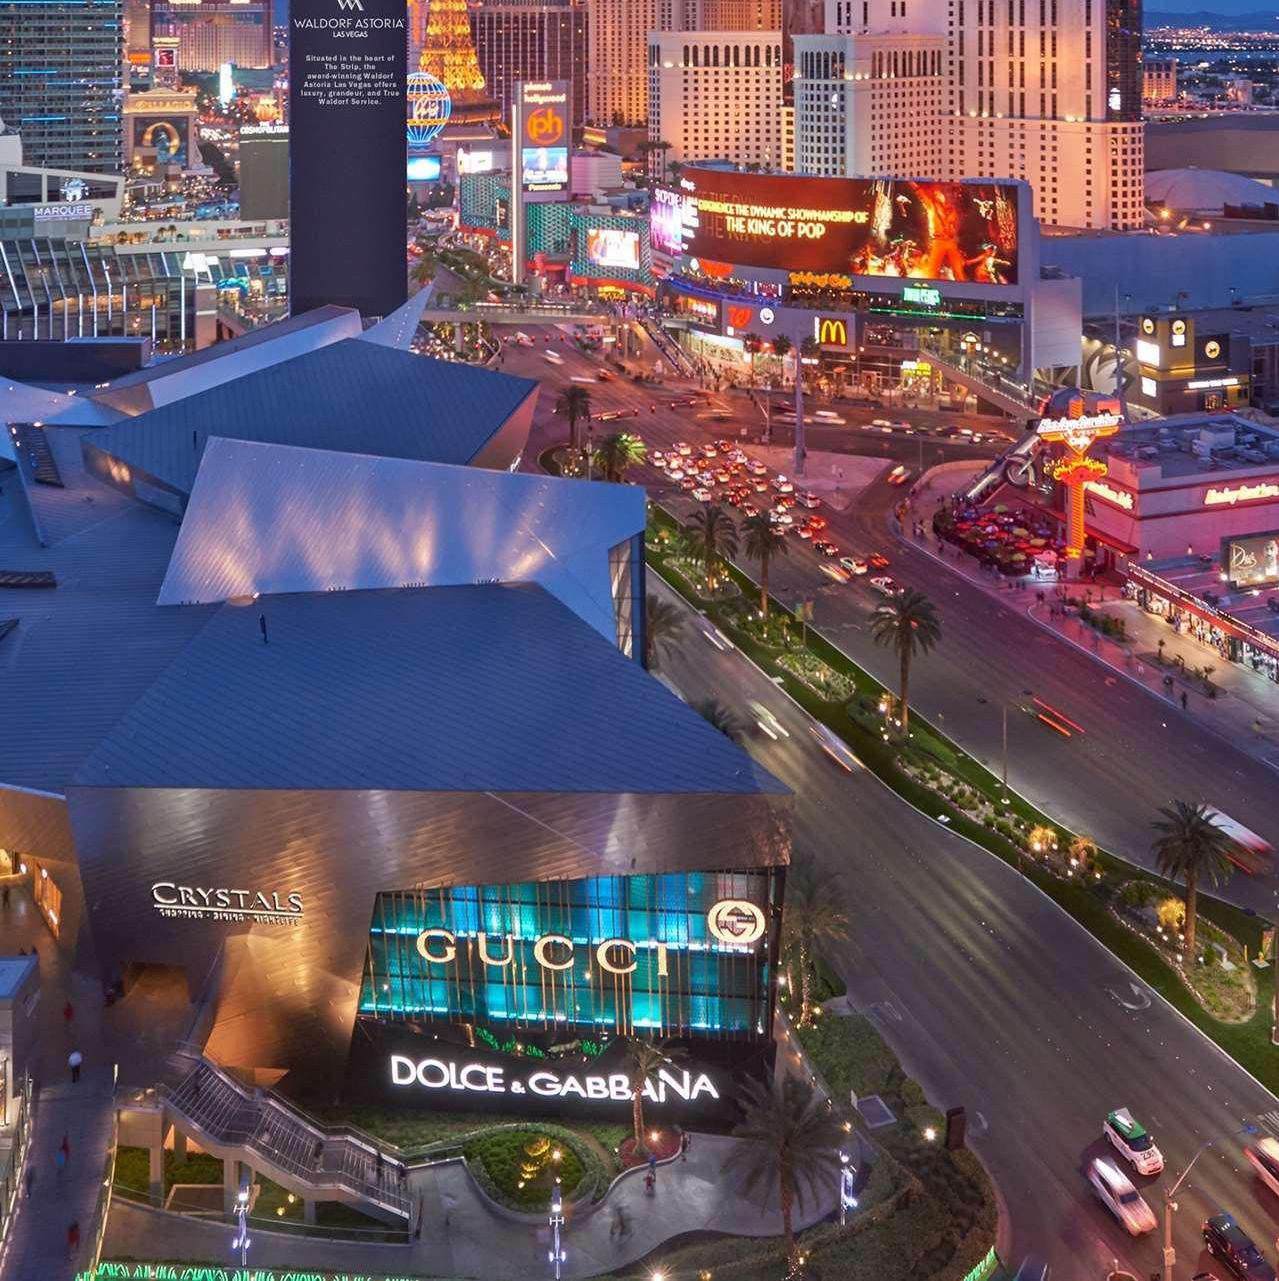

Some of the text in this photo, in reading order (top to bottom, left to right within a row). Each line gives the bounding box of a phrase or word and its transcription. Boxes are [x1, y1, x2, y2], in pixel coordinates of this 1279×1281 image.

[294, 18, 404, 29] WALDORF ASTORIA
[332, 30, 368, 38] LAS VEGAS
[305, 54, 395, 62] Situated in the heart of
[340, 63, 362, 71] Strip,
[307, 72, 394, 81] award-winning Waldorf
[348, 81, 372, 90] Vegas
[523, 81, 553, 93] planet
[300, 90, 326, 98] luxury,
[328, 90, 364, 98] grandeur,
[523, 93, 567, 105] hollywood
[318, 98, 381, 106] Waldorf Service.
[33, 205, 92, 217] MARQUEE
[735, 203, 749, 218] THE
[750, 206, 787, 220] DYNAMIC
[788, 208, 854, 223] SHOWMANSHIP
[854, 211, 869, 224] OF
[725, 215, 747, 235] THE
[747, 218, 776, 237] KING
[777, 221, 795, 238] OF
[797, 222, 826, 239] POP
[151, 882, 305, 913] CRYSTALS
[416, 926, 669, 976] GUCCI
[390, 1054, 720, 1103] DOLCE & GABBANA
